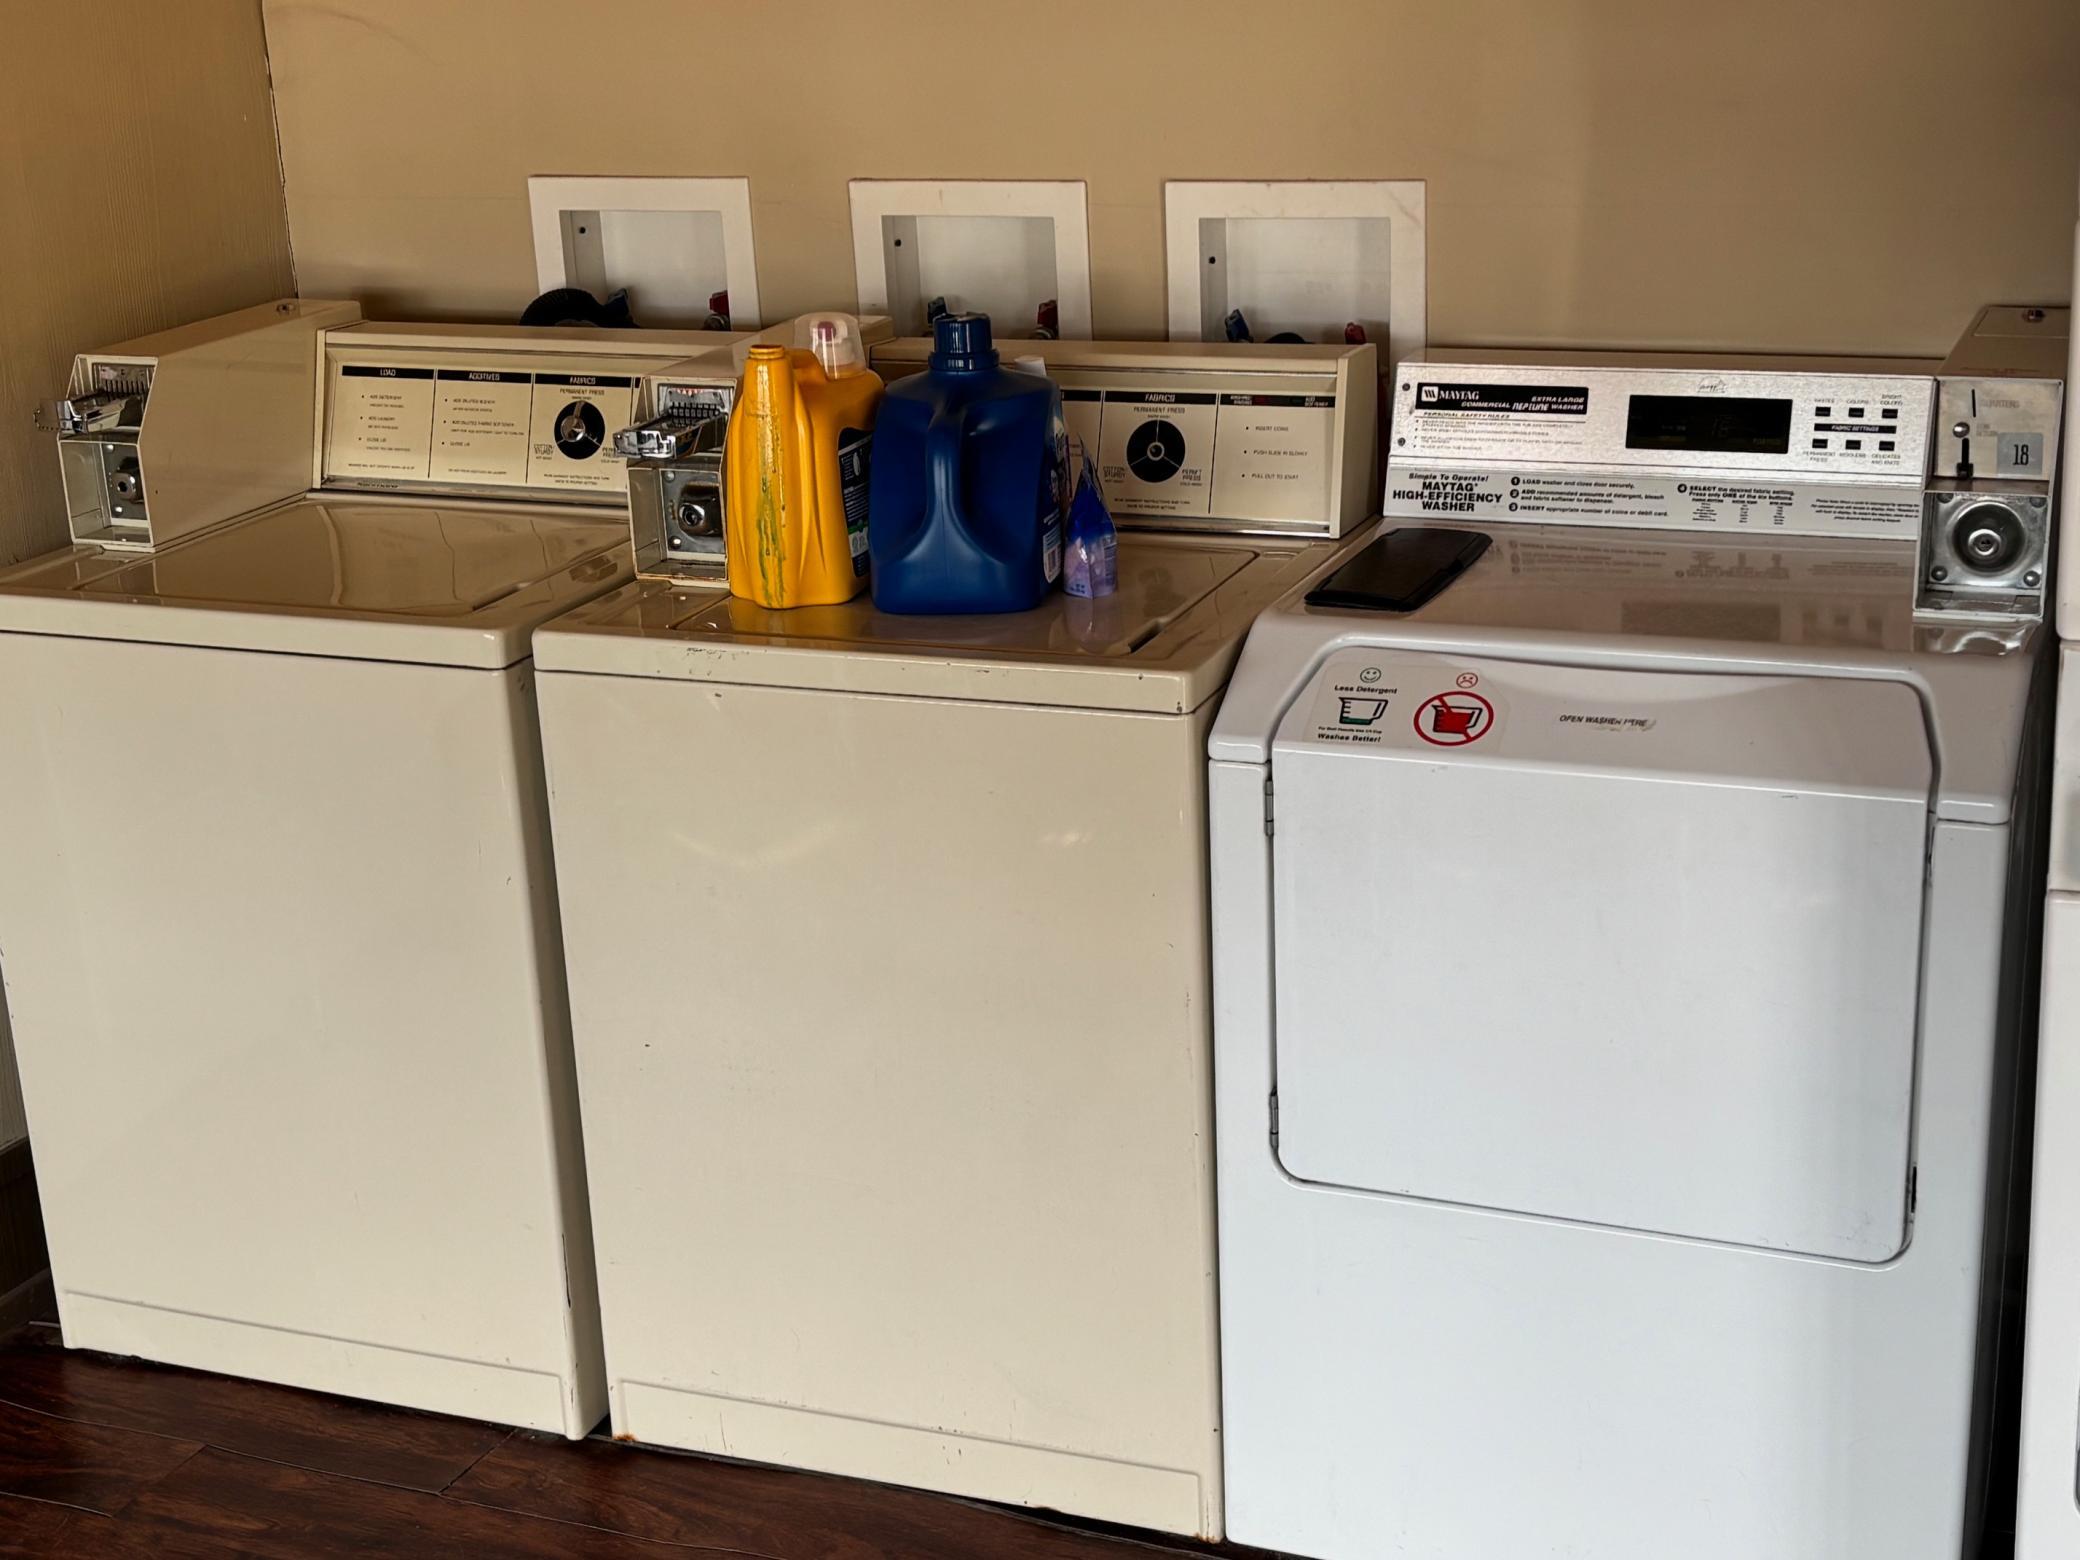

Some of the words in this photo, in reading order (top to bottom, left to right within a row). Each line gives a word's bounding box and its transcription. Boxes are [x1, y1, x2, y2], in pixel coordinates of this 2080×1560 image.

[1439, 390, 1479, 400] MAYTAG
[2013, 444, 2029, 465] 18
[1409, 472, 1437, 481] Simple
[1452, 474, 1489, 482] Operate!
[1393, 490, 1503, 503] HIGH-EFFICIENCY
[1422, 501, 1475, 512] WASHER
[1356, 686, 1397, 694] Detergent
